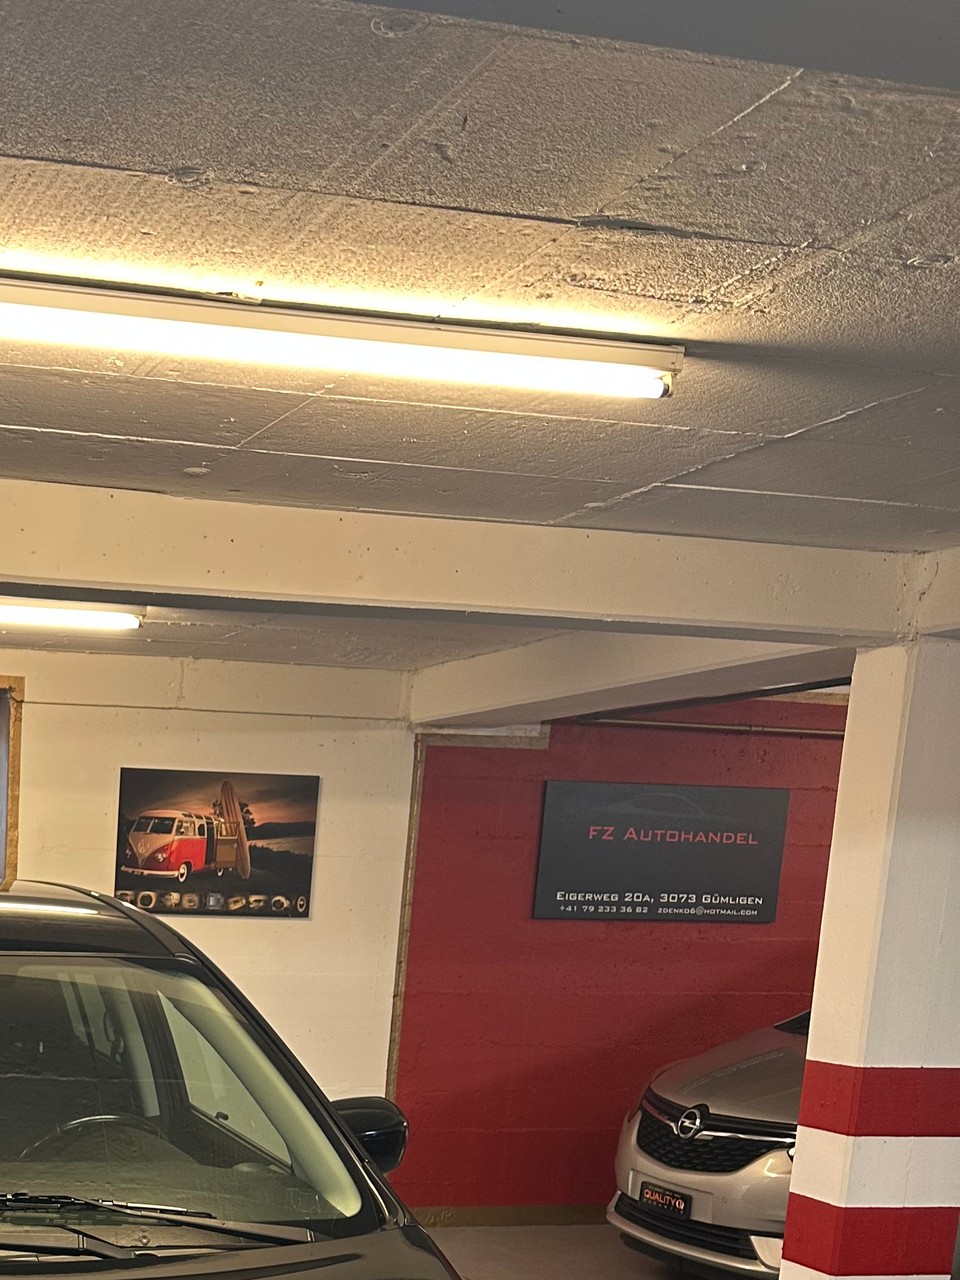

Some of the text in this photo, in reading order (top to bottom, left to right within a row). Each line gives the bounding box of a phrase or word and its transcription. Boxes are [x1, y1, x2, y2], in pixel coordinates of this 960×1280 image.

[589, 826, 759, 845] FZ AUTOHANDEL
[556, 891, 763, 905] EIGERWEG 20A, 3073 GÜMLIGEN
[559, 905, 578, 913] +41
[582, 905, 595, 913] 79
[598, 905, 617, 914] 233
[620, 906, 633, 914] 36
[644, 1189, 676, 1206] QUALITY
